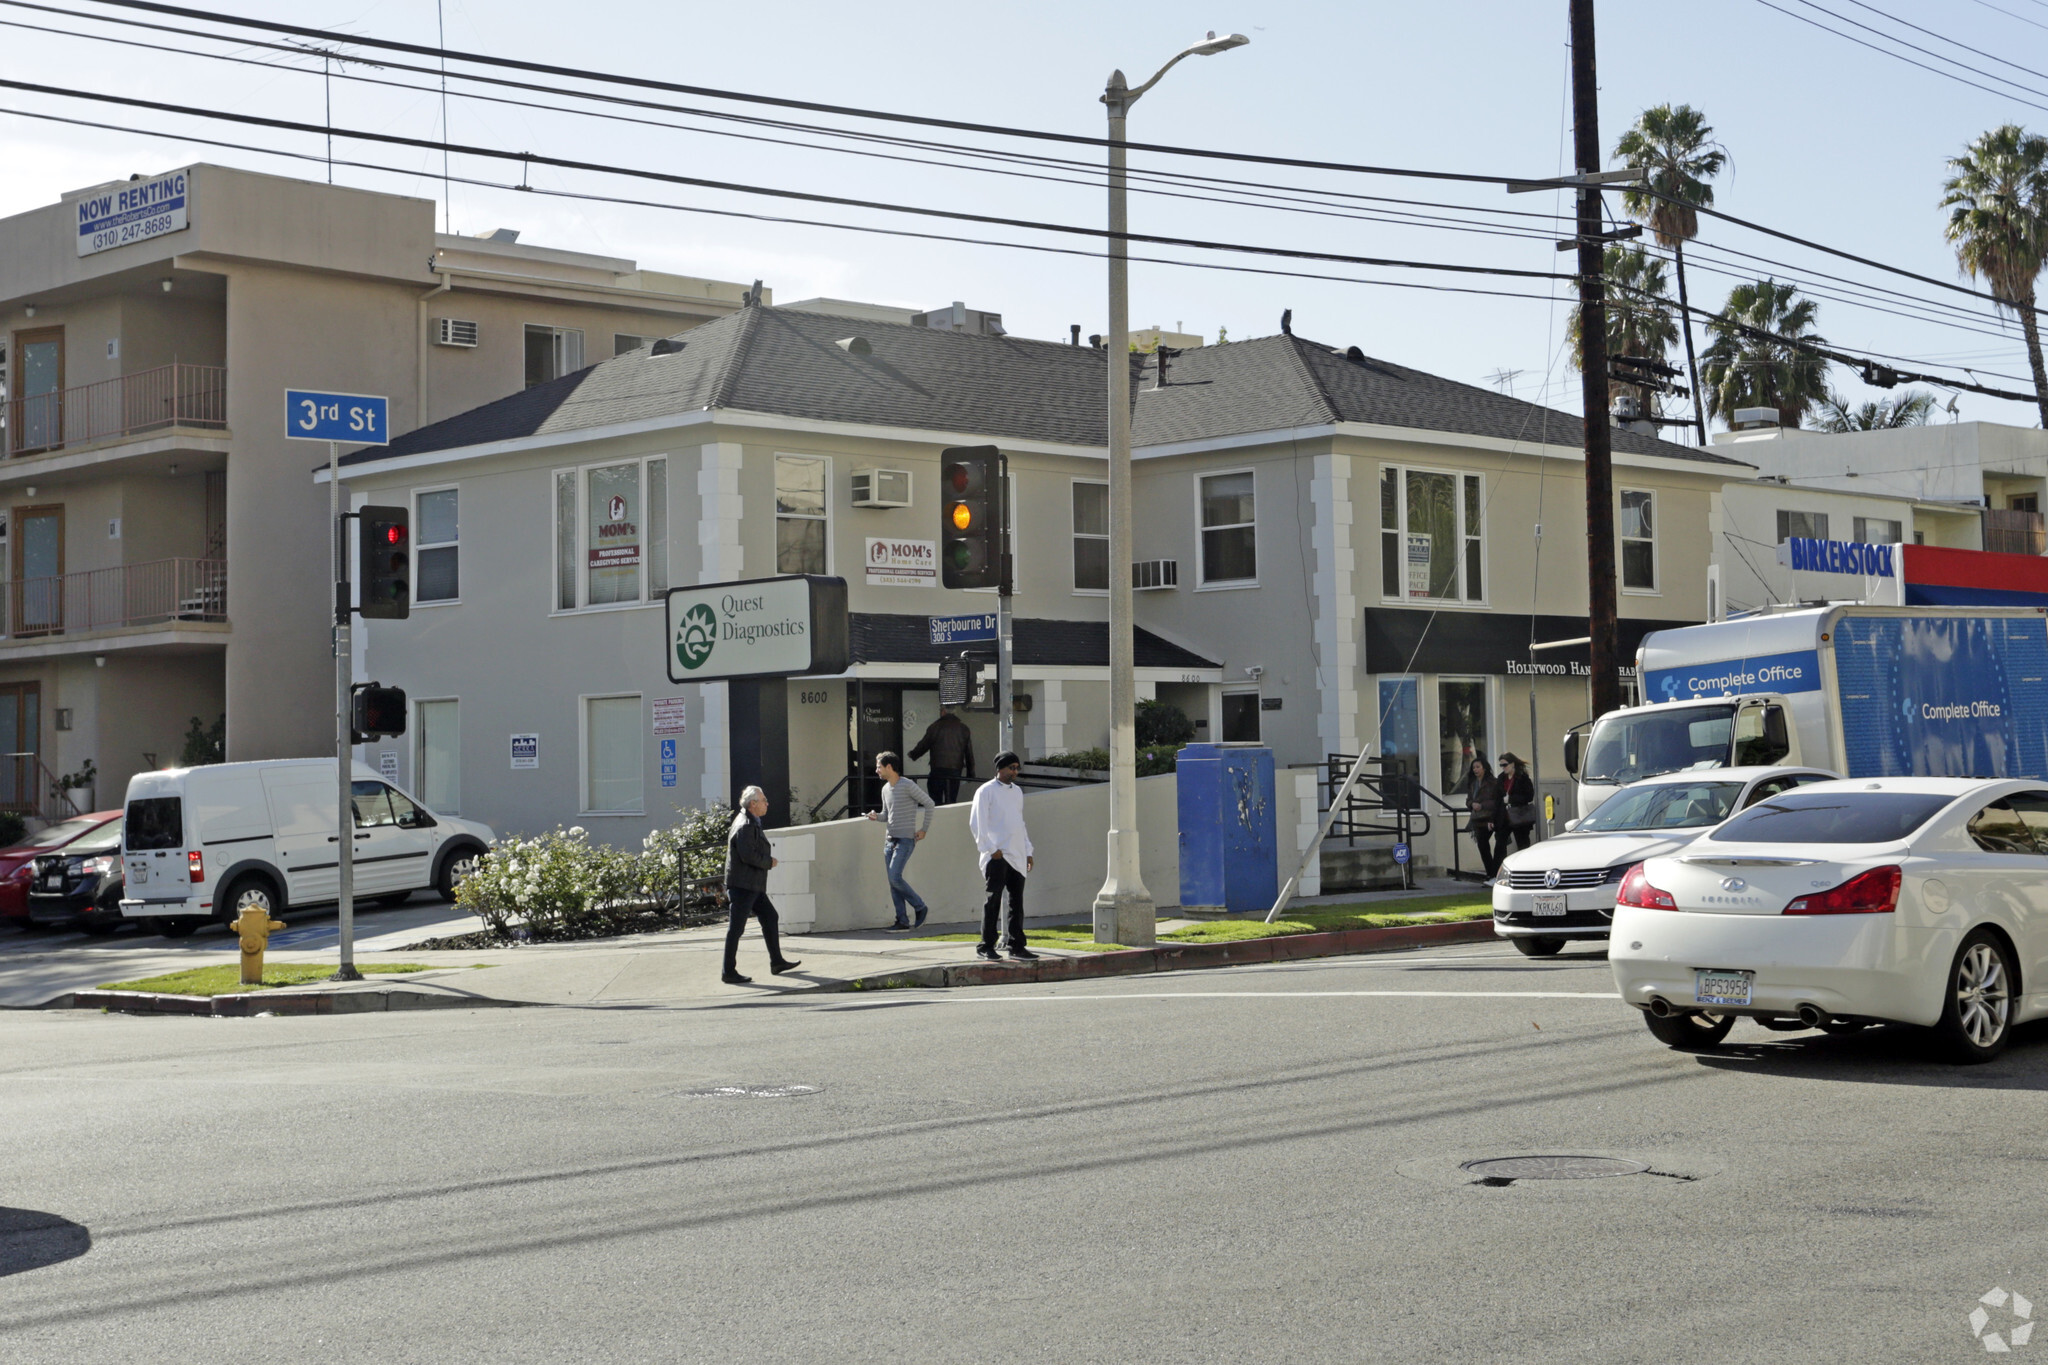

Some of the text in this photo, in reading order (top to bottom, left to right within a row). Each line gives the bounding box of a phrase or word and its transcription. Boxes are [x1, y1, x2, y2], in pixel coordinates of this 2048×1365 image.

[80, 175, 185, 222] NOW RENTING
[93, 215, 172, 250] (310) 247-8689
[299, 399, 376, 432] 3rd St
[891, 543, 932, 558] MOM's
[1790, 536, 1895, 578] BIRKENSTOCK
[1408, 571, 1428, 580] FFICE
[721, 594, 764, 618] Quest
[722, 618, 804, 645] Diagnostics
[932, 615, 996, 633] Sherbourne Dr
[932, 632, 952, 642] 300 S
[1570, 661, 1591, 675] HAN
[1688, 666, 1802, 692] Complete Office
[801, 691, 828, 704] 8600
[865, 707, 880, 715] Quest
[1922, 700, 2001, 723] Complete Office
[1704, 978, 1749, 996] BPS3958
